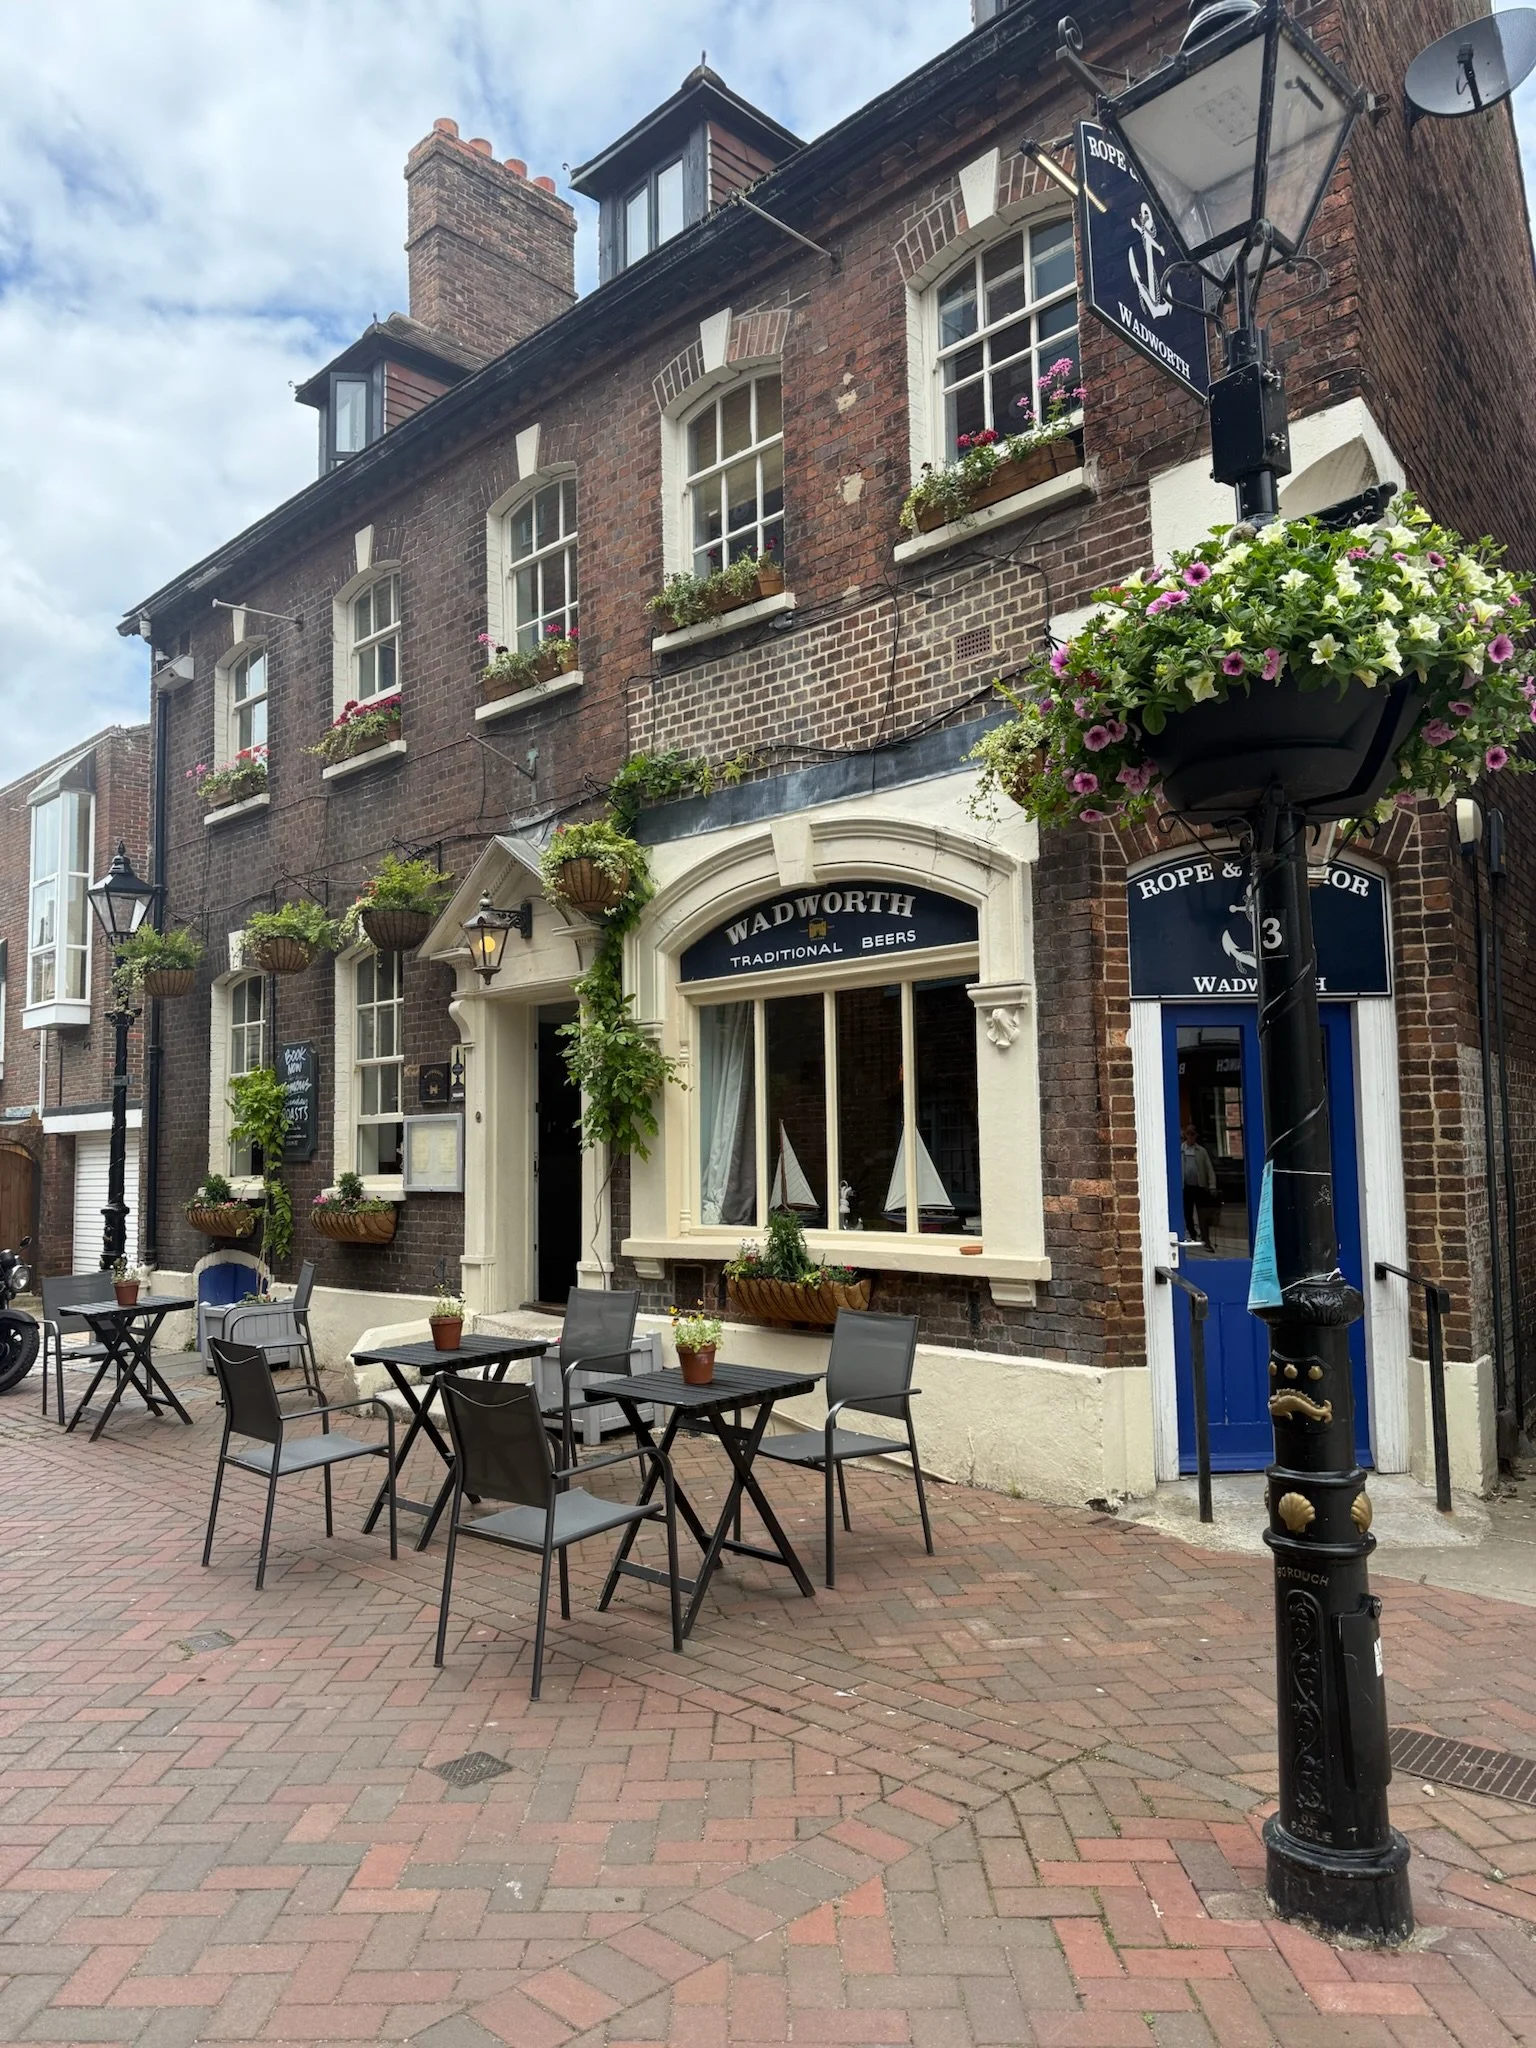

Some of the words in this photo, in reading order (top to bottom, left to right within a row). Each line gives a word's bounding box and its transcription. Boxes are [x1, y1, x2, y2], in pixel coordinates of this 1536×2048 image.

[1087, 135, 1127, 172] ROPE
[1117, 301, 1190, 379] WADWORTH
[1136, 862, 1215, 900] ROPE
[1222, 862, 1243, 879] &
[724, 890, 916, 946] WADWORTH
[1261, 916, 1283, 950] 3
[730, 941, 843, 968] TRADITIONAL
[862, 930, 917, 949] BEERS
[1193, 975, 1327, 993] WADWH
[1276, 1567, 1329, 1586] BOROUGH
